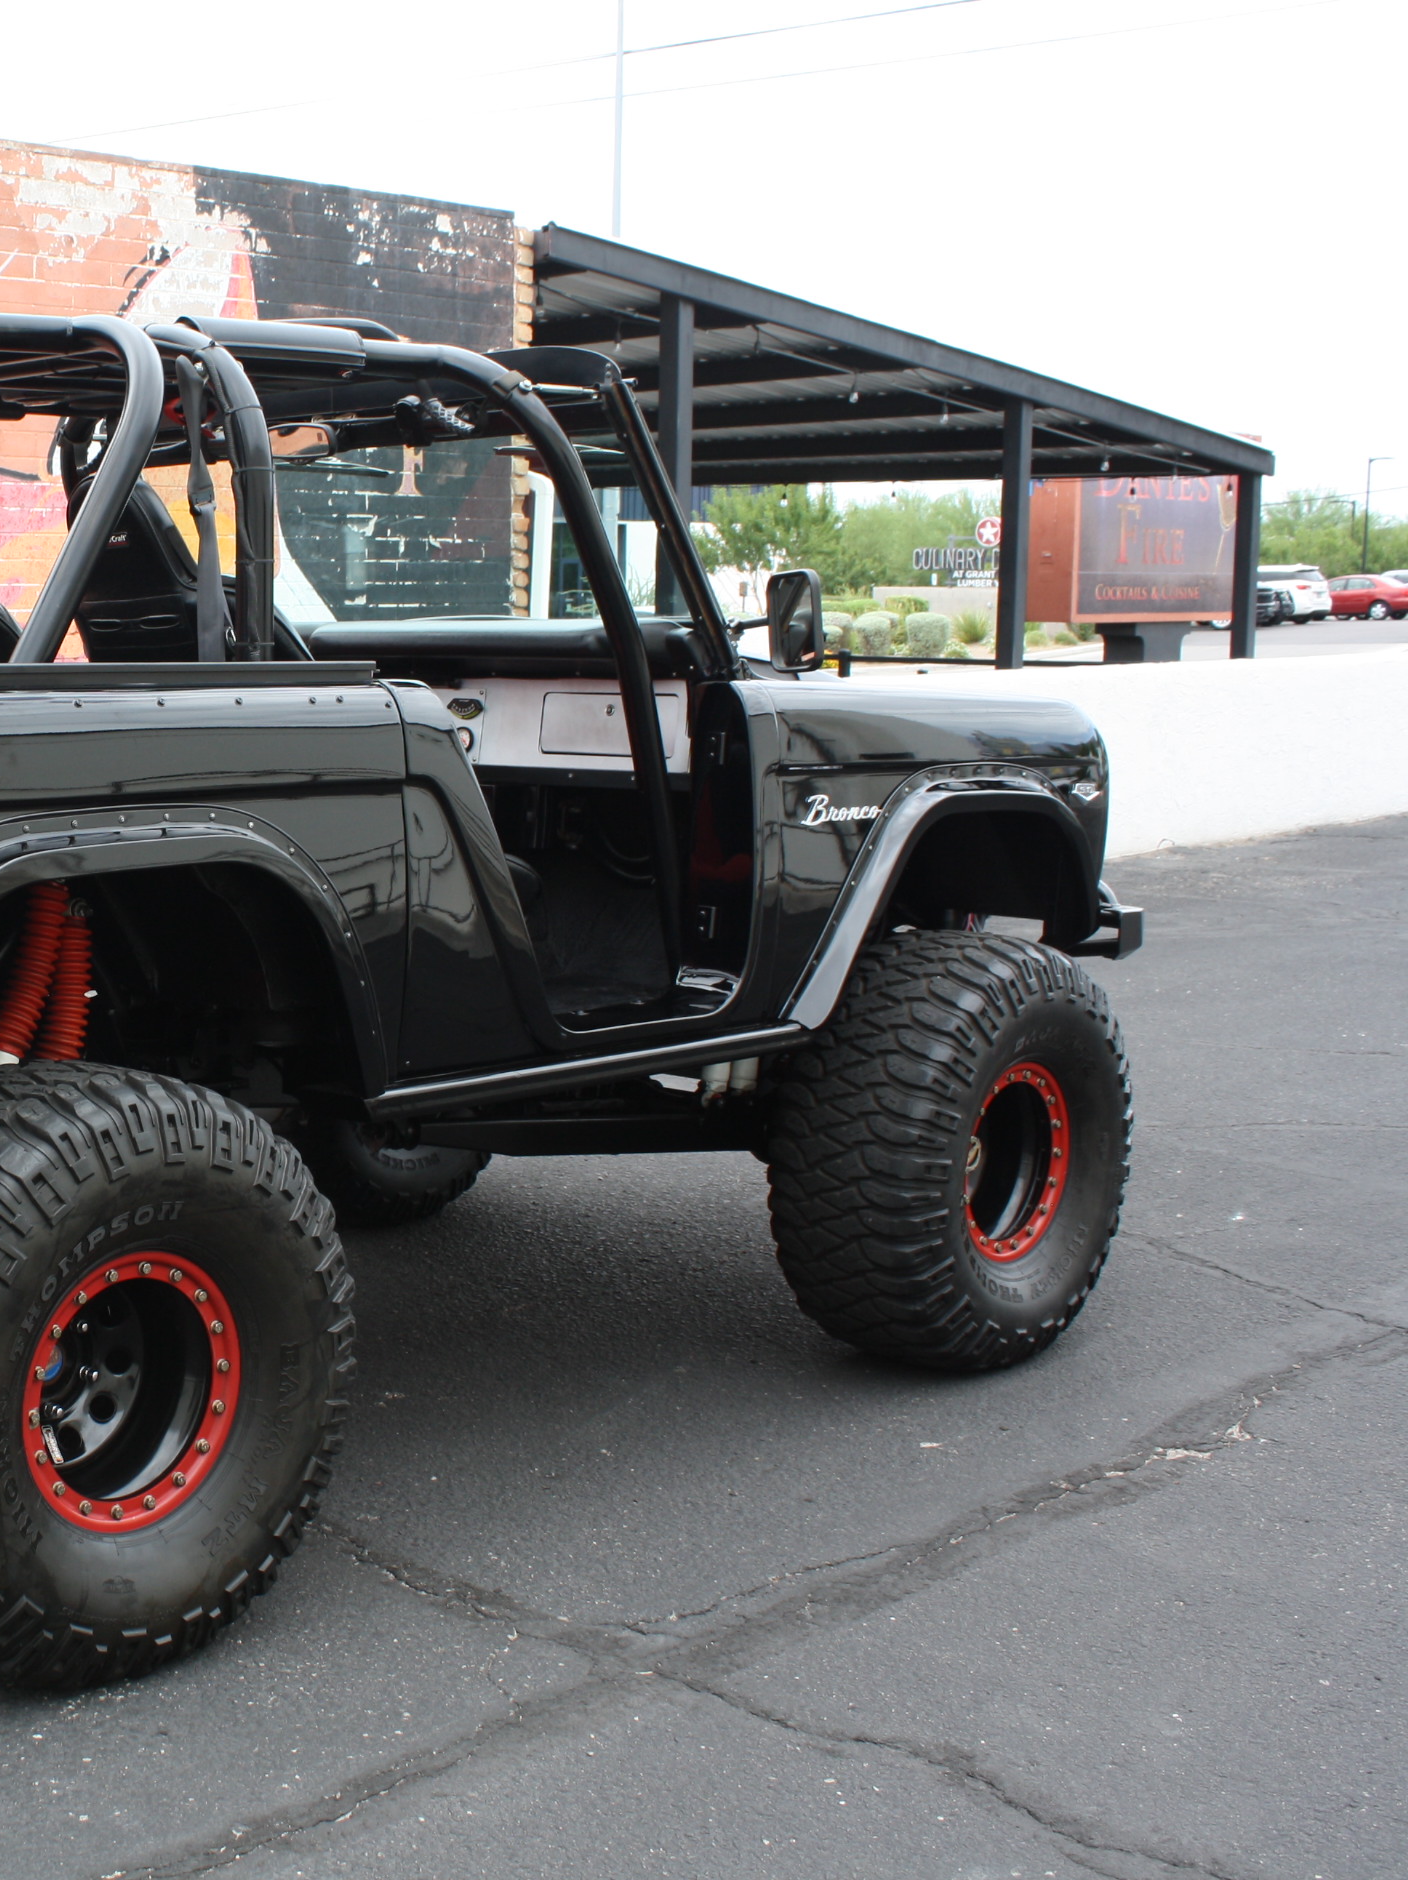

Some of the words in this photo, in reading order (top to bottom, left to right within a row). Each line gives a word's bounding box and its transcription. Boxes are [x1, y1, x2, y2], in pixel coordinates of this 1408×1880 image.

[1115, 503, 1185, 565] FIRE
[913, 547, 985, 570] CULINARY
[952, 570, 965, 579] AT
[965, 570, 996, 579] GRANT
[957, 579, 992, 587] LUMBER
[1095, 583, 1149, 601] COCKTAILS
[800, 794, 883, 827] Bronco
[12, 1200, 184, 1358] THOMPSON
